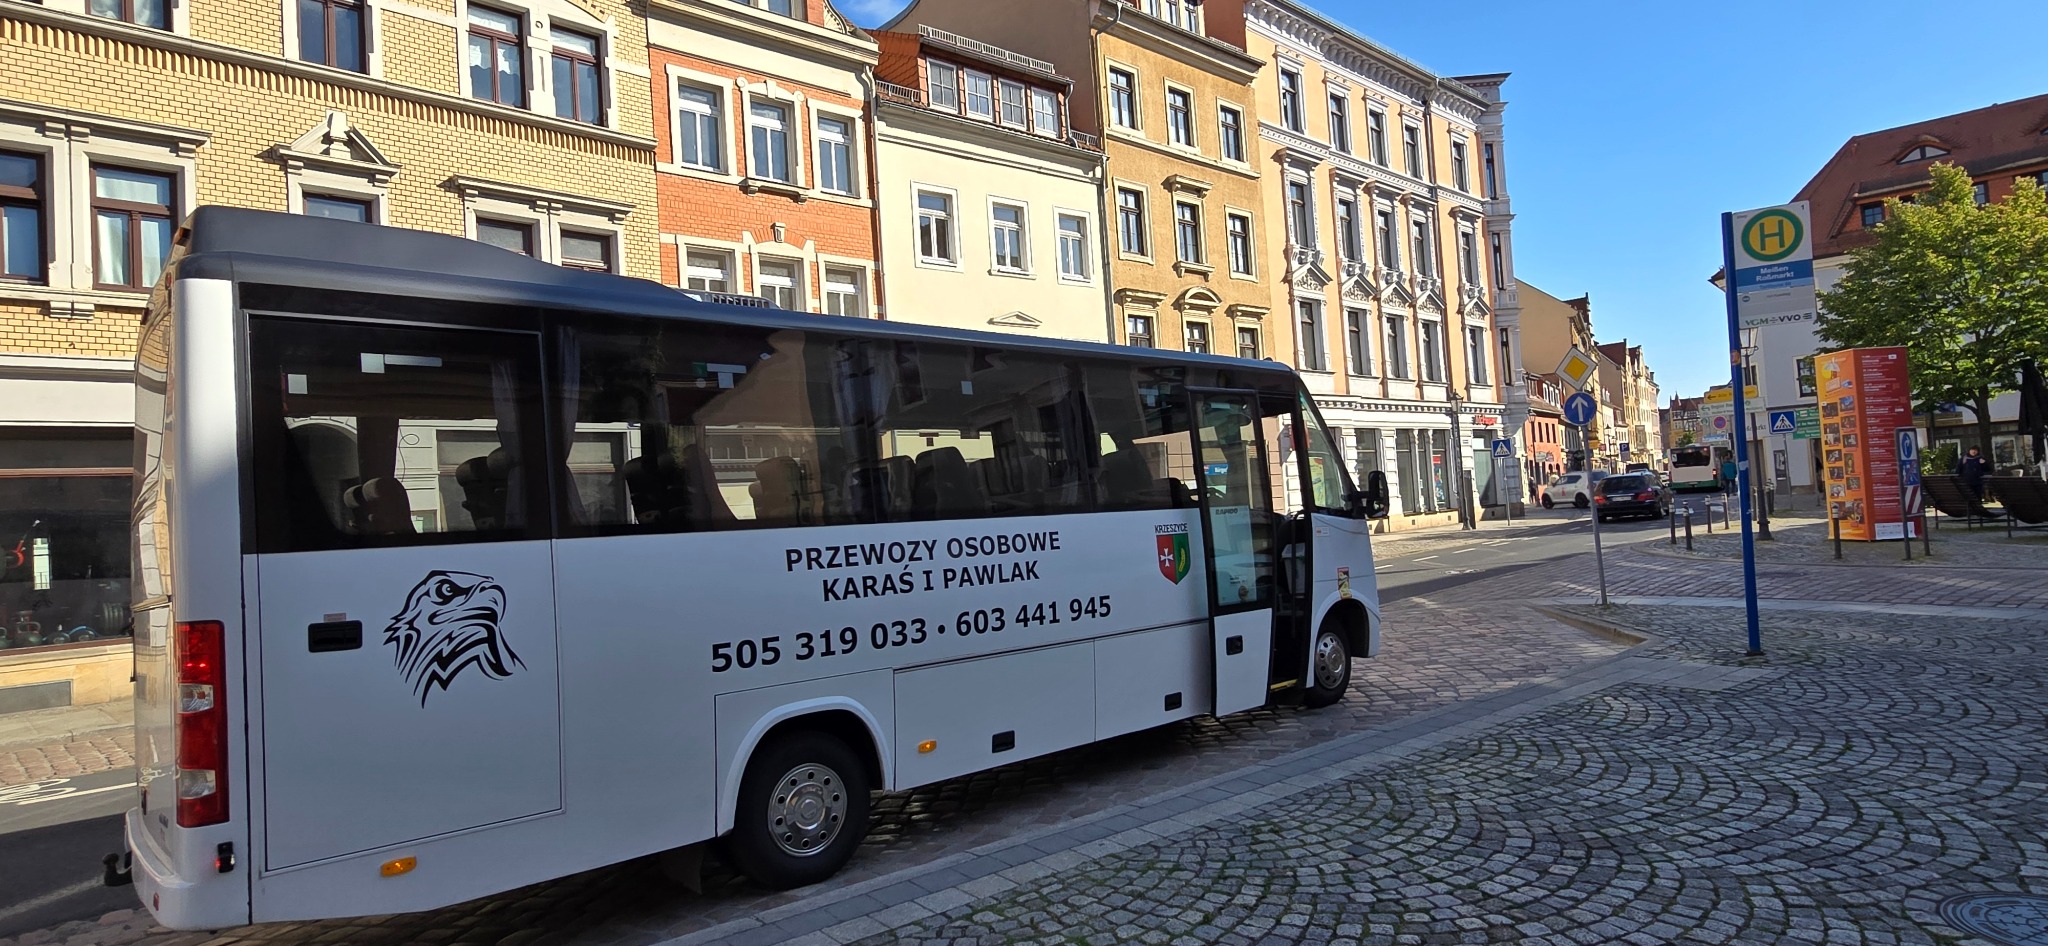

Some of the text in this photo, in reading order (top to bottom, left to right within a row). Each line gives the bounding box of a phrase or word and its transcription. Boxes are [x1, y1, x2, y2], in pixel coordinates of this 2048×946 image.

[1759, 219, 1785, 251] H
[1760, 265, 1789, 274] Meißen
[1756, 271, 1794, 282] Roßmarkt
[1779, 314, 1801, 322] VVO
[1215, 507, 1239, 515] RAPIDO
[1154, 522, 1188, 534] KRZESZYCE
[785, 531, 1061, 572] PRZEWOZY OSOBOWE
[822, 560, 1040, 602] KARAŚ I PAWLAK
[711, 636, 781, 673] 505
[795, 626, 858, 661] 319
[870, 618, 928, 650] 033
[956, 607, 1006, 637] 603
[1015, 601, 1060, 628] 441
[1069, 595, 1112, 622] 945
